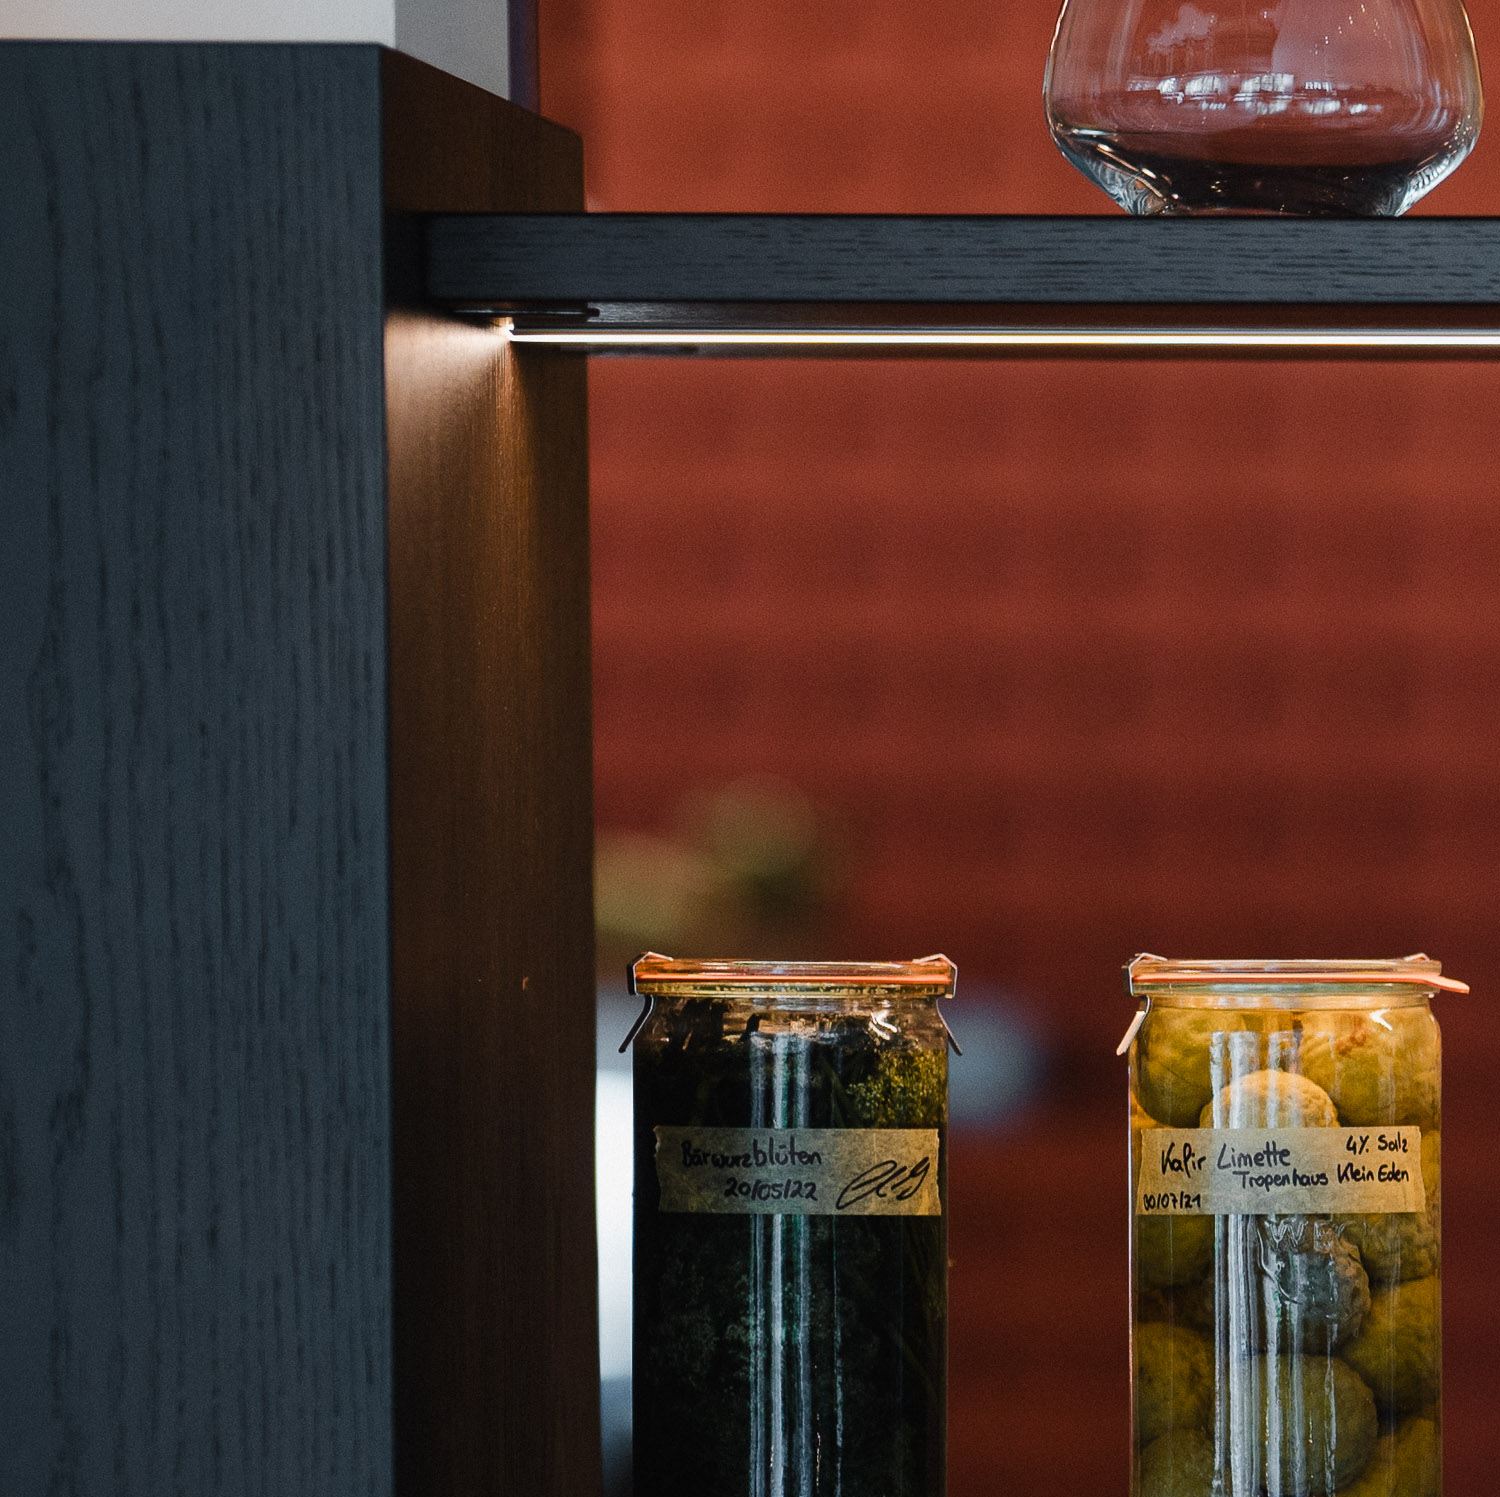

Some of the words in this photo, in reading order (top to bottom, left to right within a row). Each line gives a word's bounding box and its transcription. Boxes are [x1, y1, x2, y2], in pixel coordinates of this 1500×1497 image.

[1377, 1132, 1409, 1154] Salz
[1161, 1142, 1206, 1178] Kafir
[1217, 1141, 1291, 1169] Limette
[724, 1177, 818, 1201] 20/05/22
[1233, 1168, 1328, 1192] Tropenhaus
[1337, 1163, 1374, 1184] Klein
[1378, 1162, 1409, 1183] Eden
